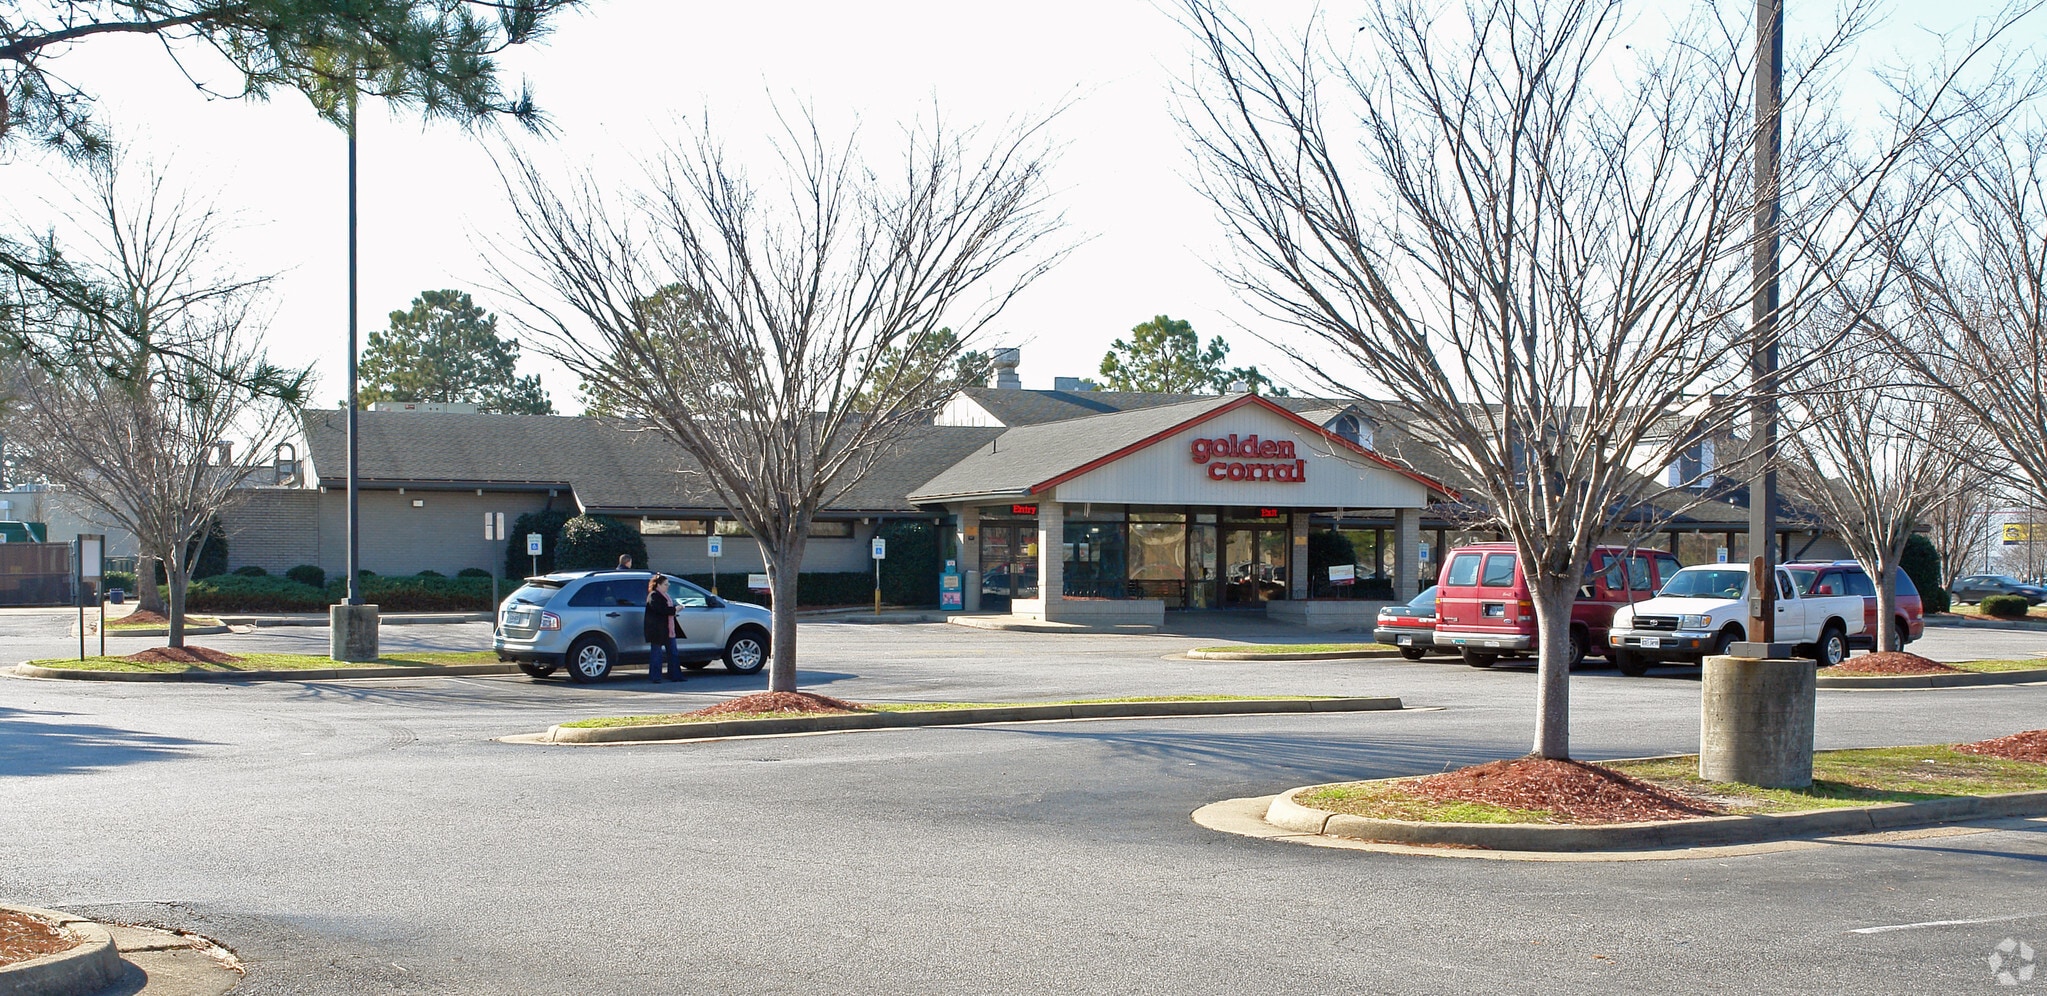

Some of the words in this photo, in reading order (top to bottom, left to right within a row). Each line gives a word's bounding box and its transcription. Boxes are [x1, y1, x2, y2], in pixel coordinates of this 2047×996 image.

[1191, 434, 1296, 464] golden
[1208, 459, 1306, 482] corral
[1013, 504, 1037, 515] Entry
[1261, 508, 1278, 517] Exit
